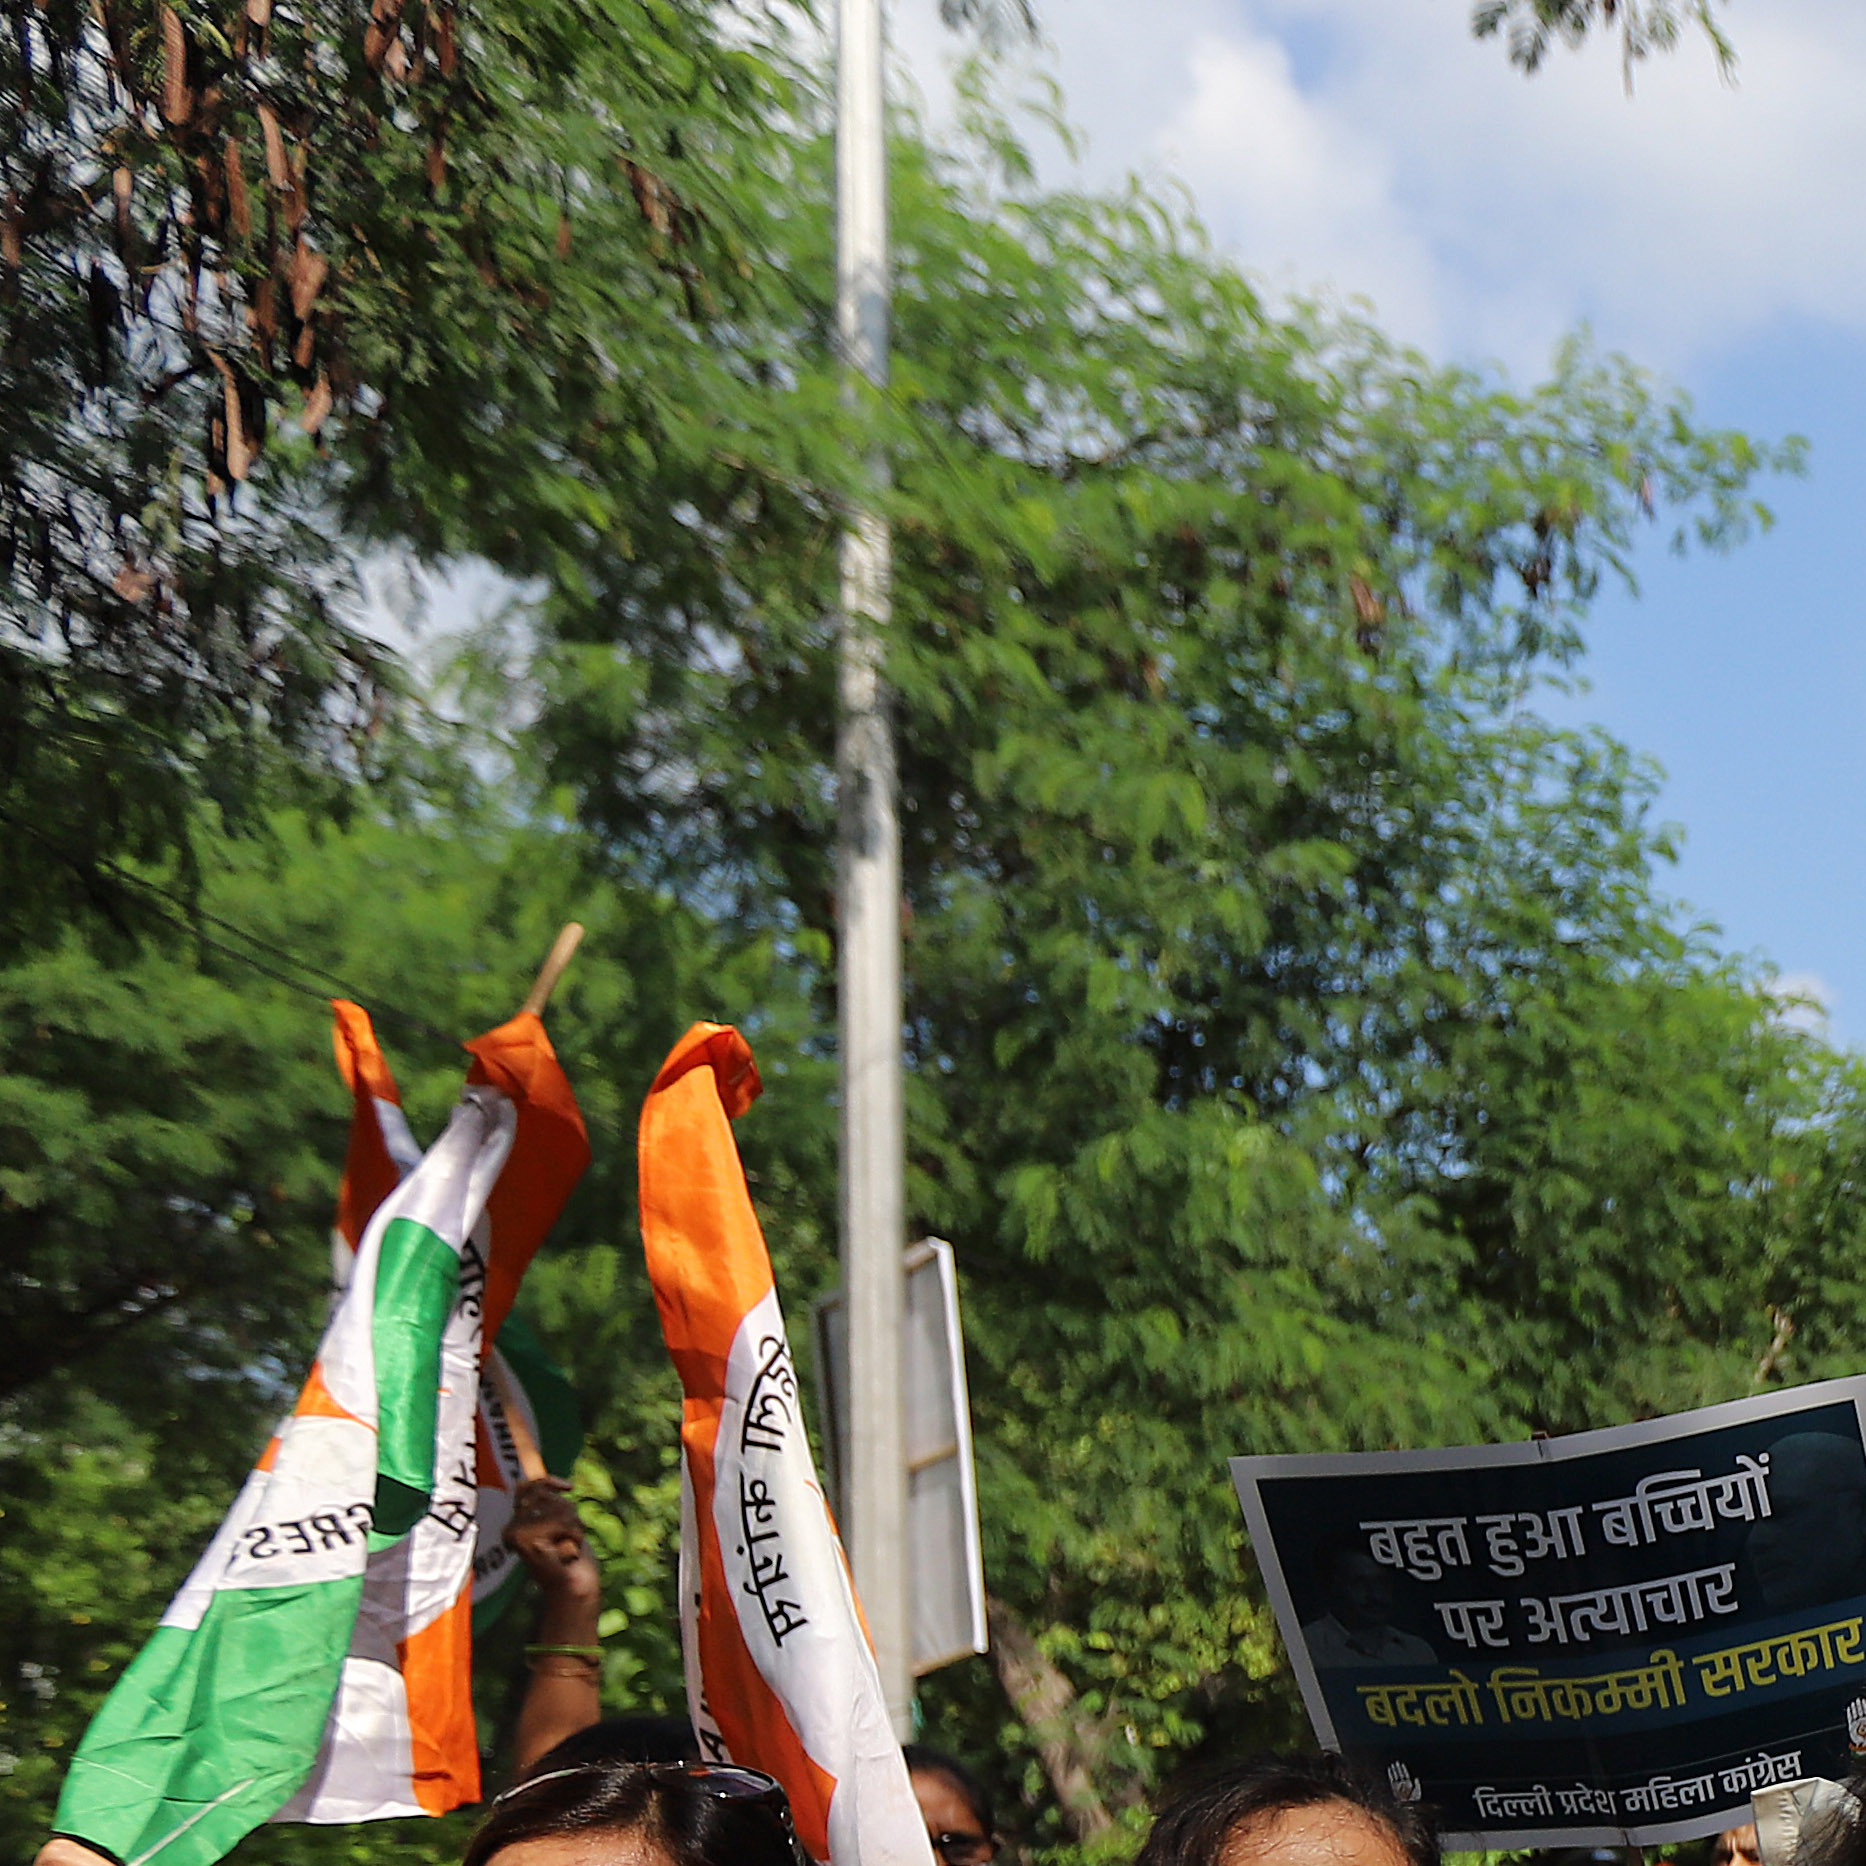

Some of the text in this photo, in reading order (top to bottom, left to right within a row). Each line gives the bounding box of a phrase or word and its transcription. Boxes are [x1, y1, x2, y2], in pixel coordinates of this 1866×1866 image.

[738, 1472, 809, 1647] कांग्रेस
[1359, 1452, 1773, 1582] बहुत हुआ बच्चियों
[1433, 1562, 1739, 1650] पर अत्याचार
[1356, 1616, 1866, 1728] बदलो निकम्मी सरकार
[1473, 1749, 1803, 1820] दिल्ली प्रदेश महिला कांग्रेस
